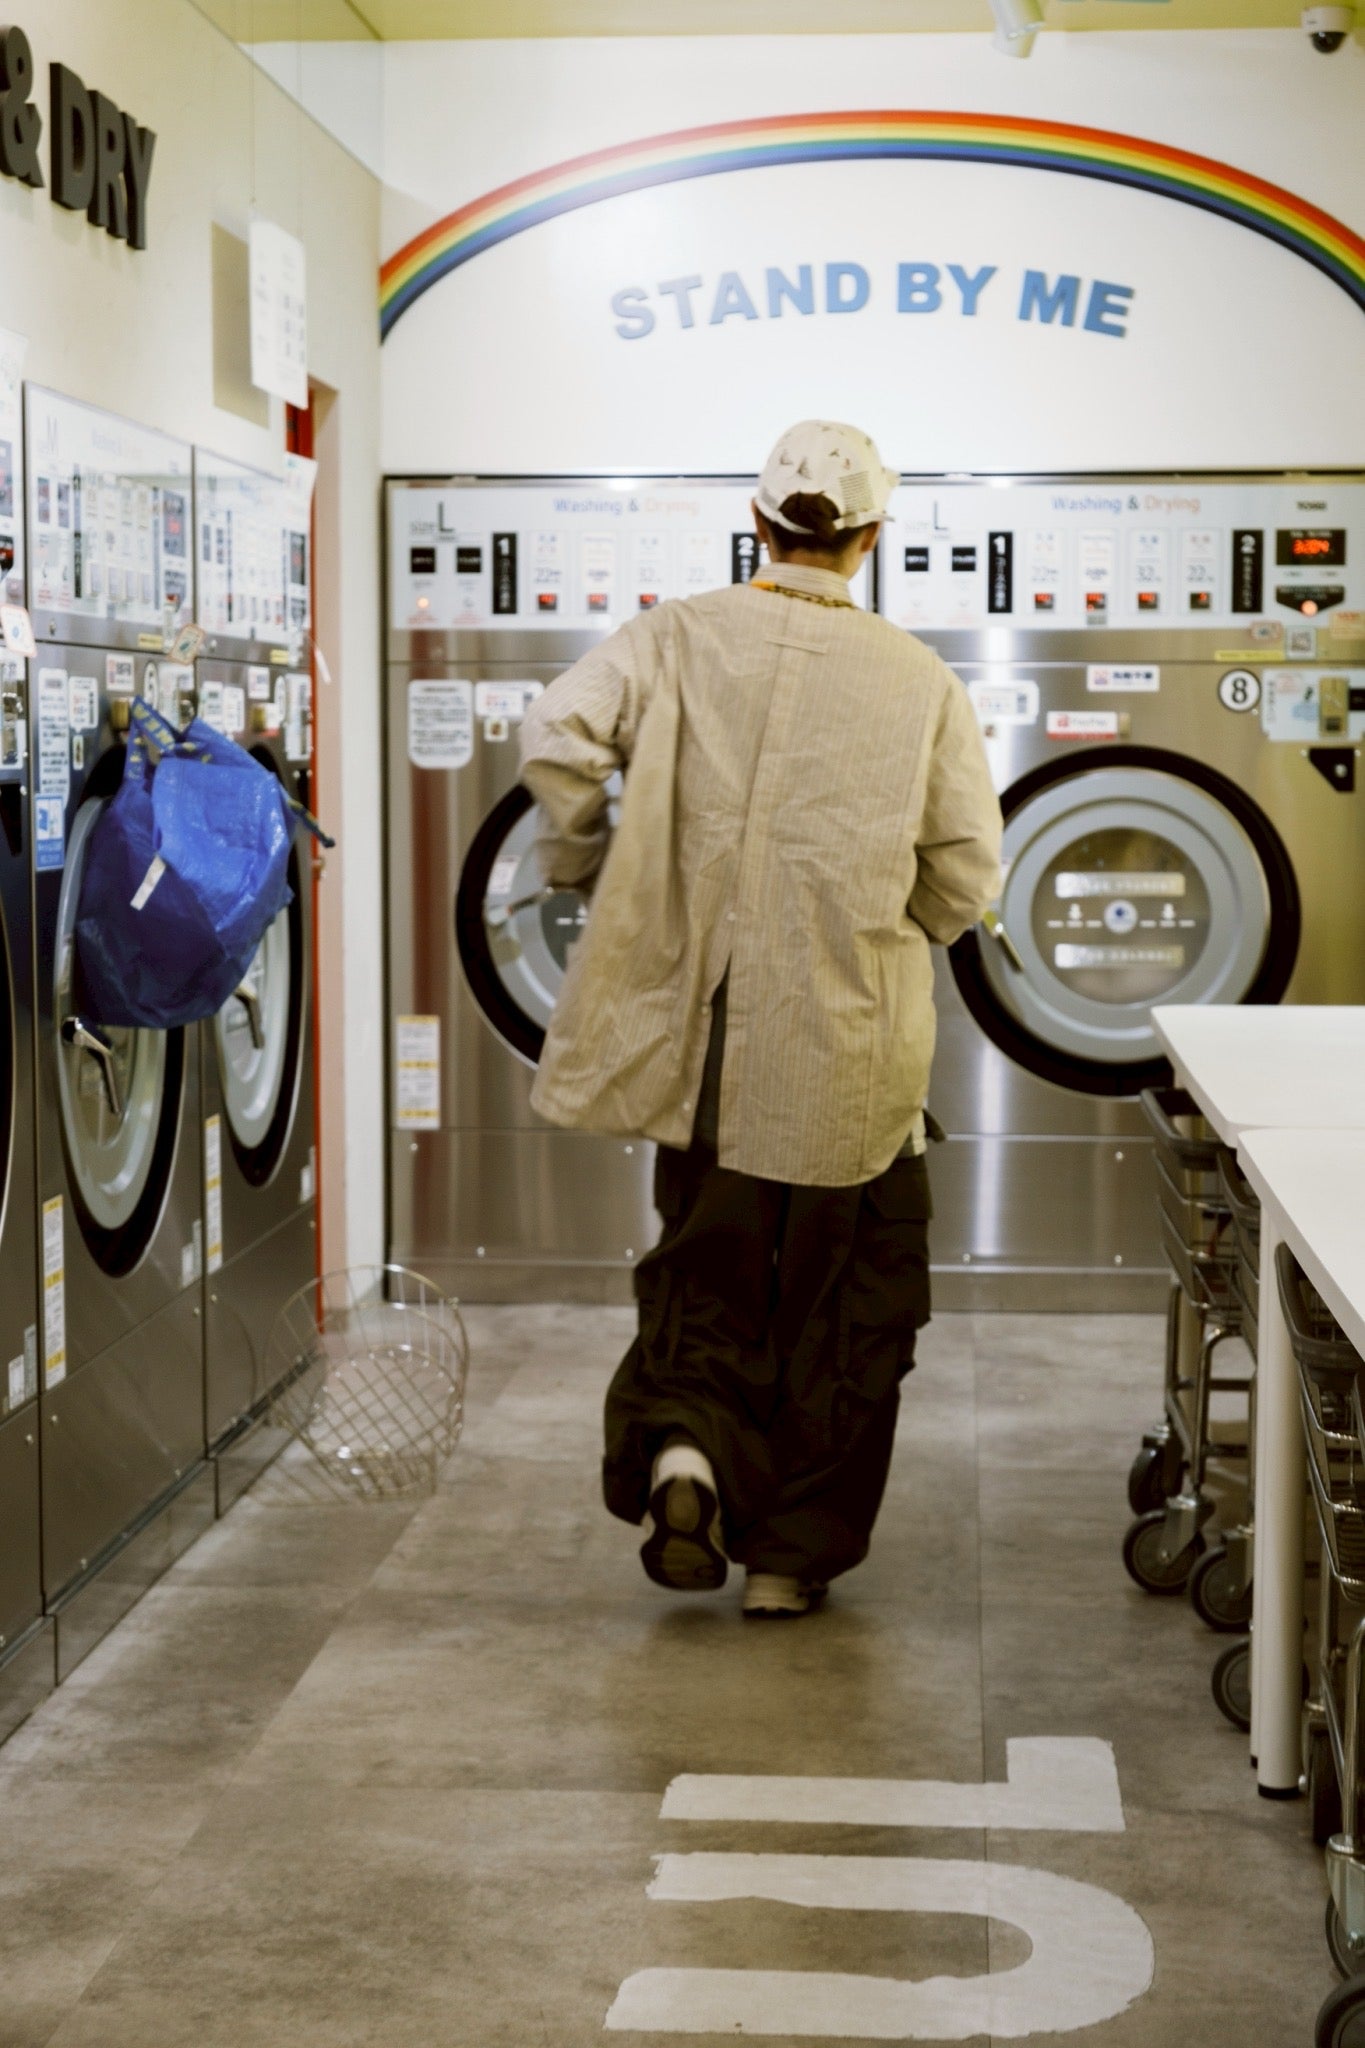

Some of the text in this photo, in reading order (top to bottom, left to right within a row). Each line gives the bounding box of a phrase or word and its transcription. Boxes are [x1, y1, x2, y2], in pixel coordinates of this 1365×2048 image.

[49, 62, 156, 250] DRY
[611, 262, 1135, 340] STAND BY ME
[553, 498, 699, 516] Washing & Drying
[933, 500, 949, 531] L
[1052, 496, 1201, 514] Washing & Drying
[438, 501, 454, 532] L
[498, 537, 510, 556] 1
[738, 536, 755, 557] 2
[994, 535, 1006, 555] 1
[1240, 534, 1256, 554] 2
[1232, 677, 1248, 704] 8
